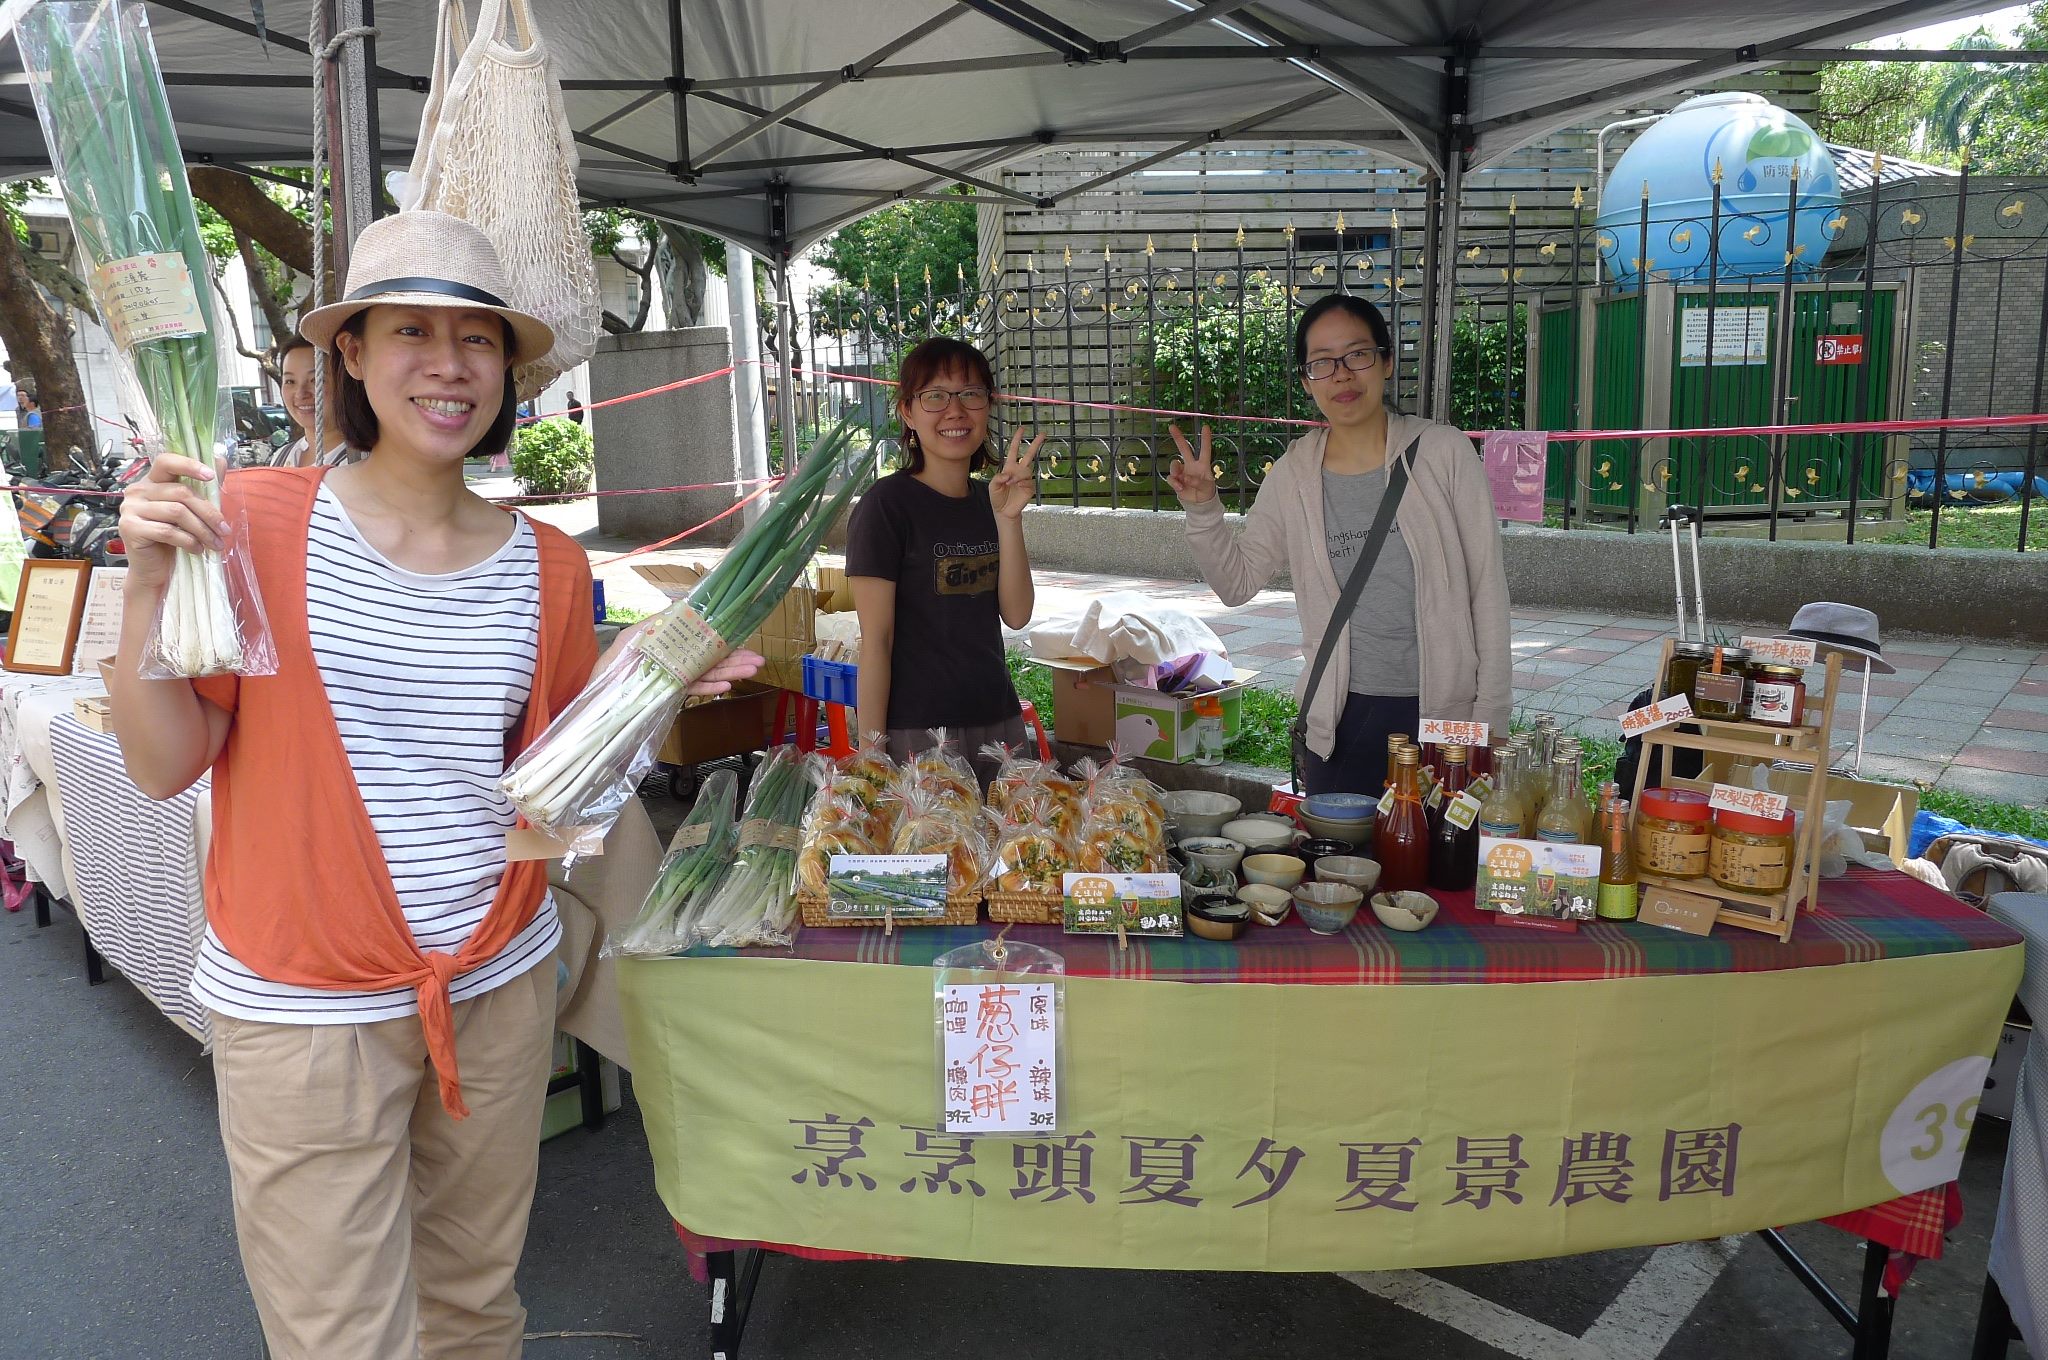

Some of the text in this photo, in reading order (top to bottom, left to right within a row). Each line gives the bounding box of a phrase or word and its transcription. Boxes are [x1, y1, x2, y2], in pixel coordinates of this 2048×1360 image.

[1763, 164, 1813, 180] 防災水
[1424, 721, 1484, 739] 水果酵素
[944, 997, 968, 1034] 咖哩
[1029, 994, 1050, 1032] 原味
[1029, 1066, 1052, 1103] 辣味
[1029, 1111, 1055, 1126] 30元
